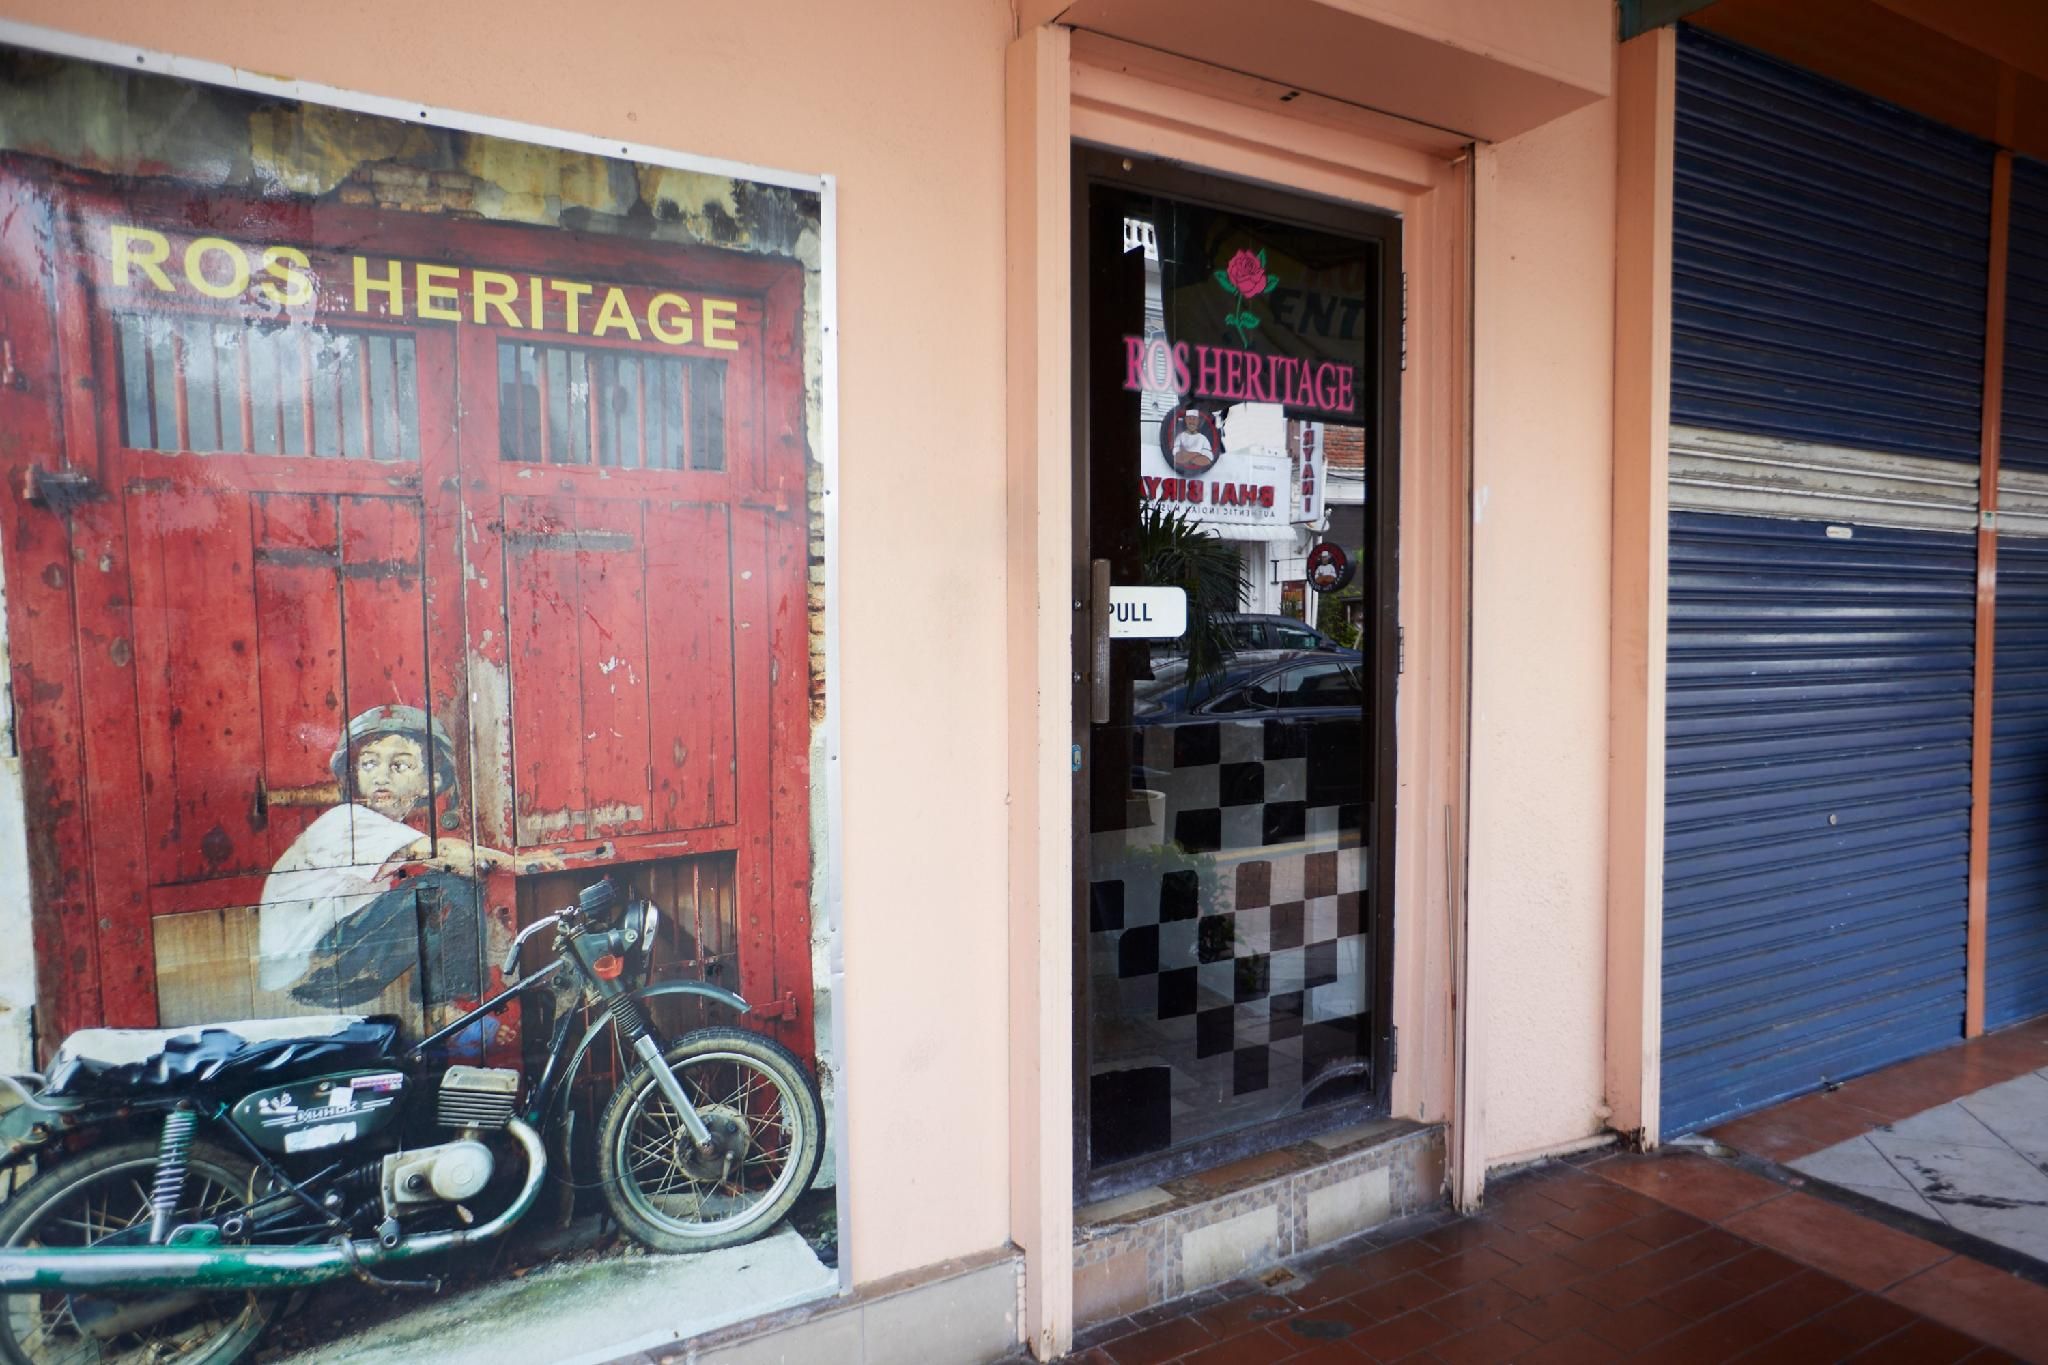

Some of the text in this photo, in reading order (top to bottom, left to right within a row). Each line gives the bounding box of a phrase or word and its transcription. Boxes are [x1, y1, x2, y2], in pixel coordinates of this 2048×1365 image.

[110, 224, 740, 350] ROS HERITAGE
[1123, 335, 1354, 413] ROS HERITAGE
